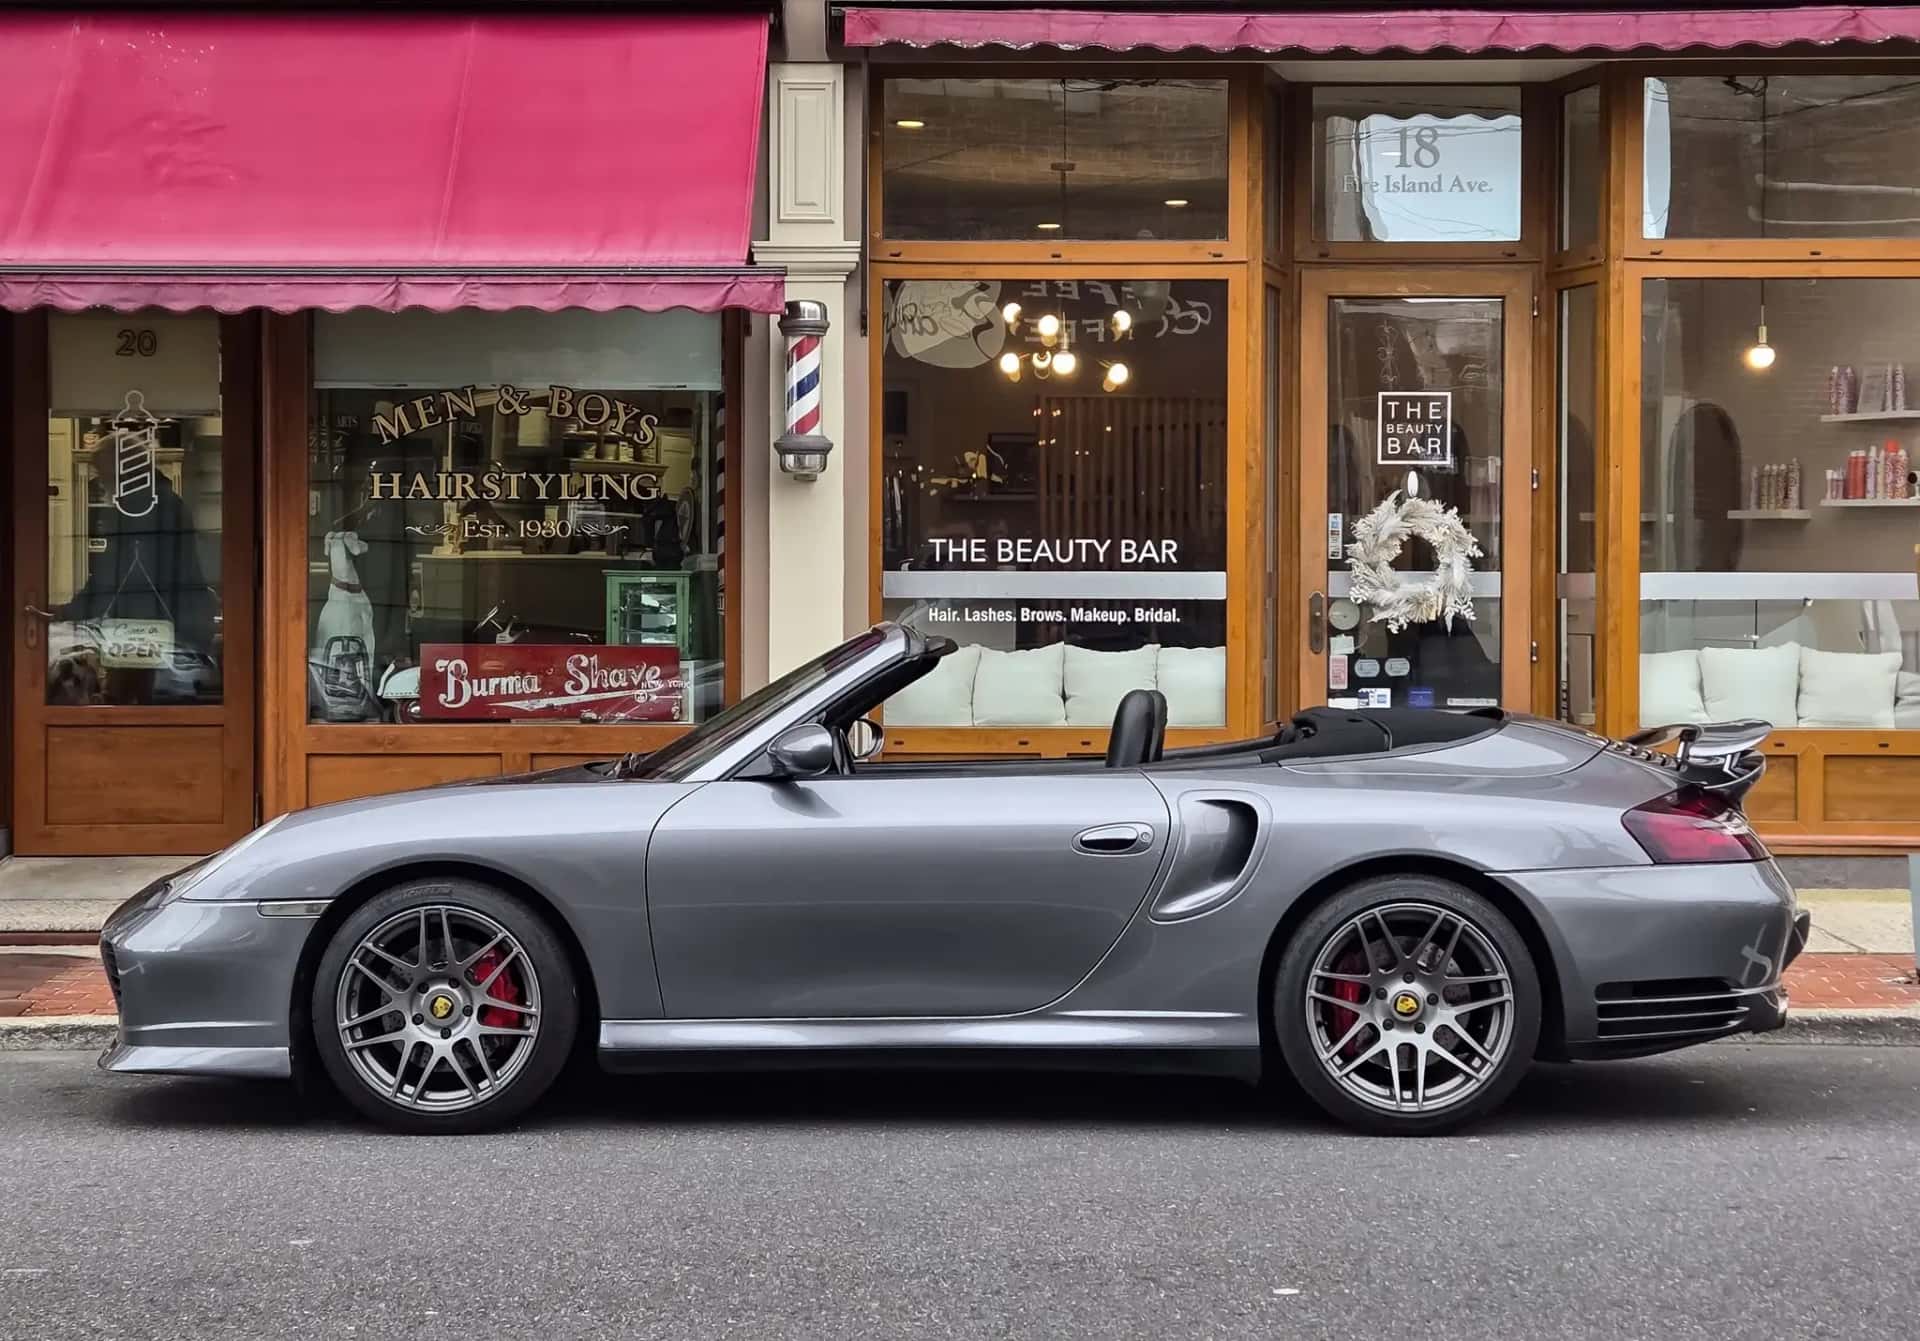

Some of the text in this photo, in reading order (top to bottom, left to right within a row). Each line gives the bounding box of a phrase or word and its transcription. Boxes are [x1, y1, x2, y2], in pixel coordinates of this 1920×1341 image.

[1395, 126, 1441, 169] 18
[1385, 174, 1442, 193] Island
[1449, 175, 1493, 193] Ave.
[115, 329, 158, 357] 20
[371, 384, 478, 446] MEN
[496, 384, 530, 416] &
[548, 385, 659, 446] BOYS
[1387, 402, 1442, 420] THE
[1386, 424, 1443, 434] BEAUTY
[1387, 438, 1441, 455] BAR
[369, 471, 660, 501] HAIRSTYLING
[519, 518, 572, 539] 1930
[928, 539, 1178, 563] THE BEAUTY BAR
[928, 608, 1181, 625] Hair. Lashes. Brows. Makeup. Bridal.
[109, 642, 162, 658] OPEN
[435, 654, 661, 709] Burma Shave
